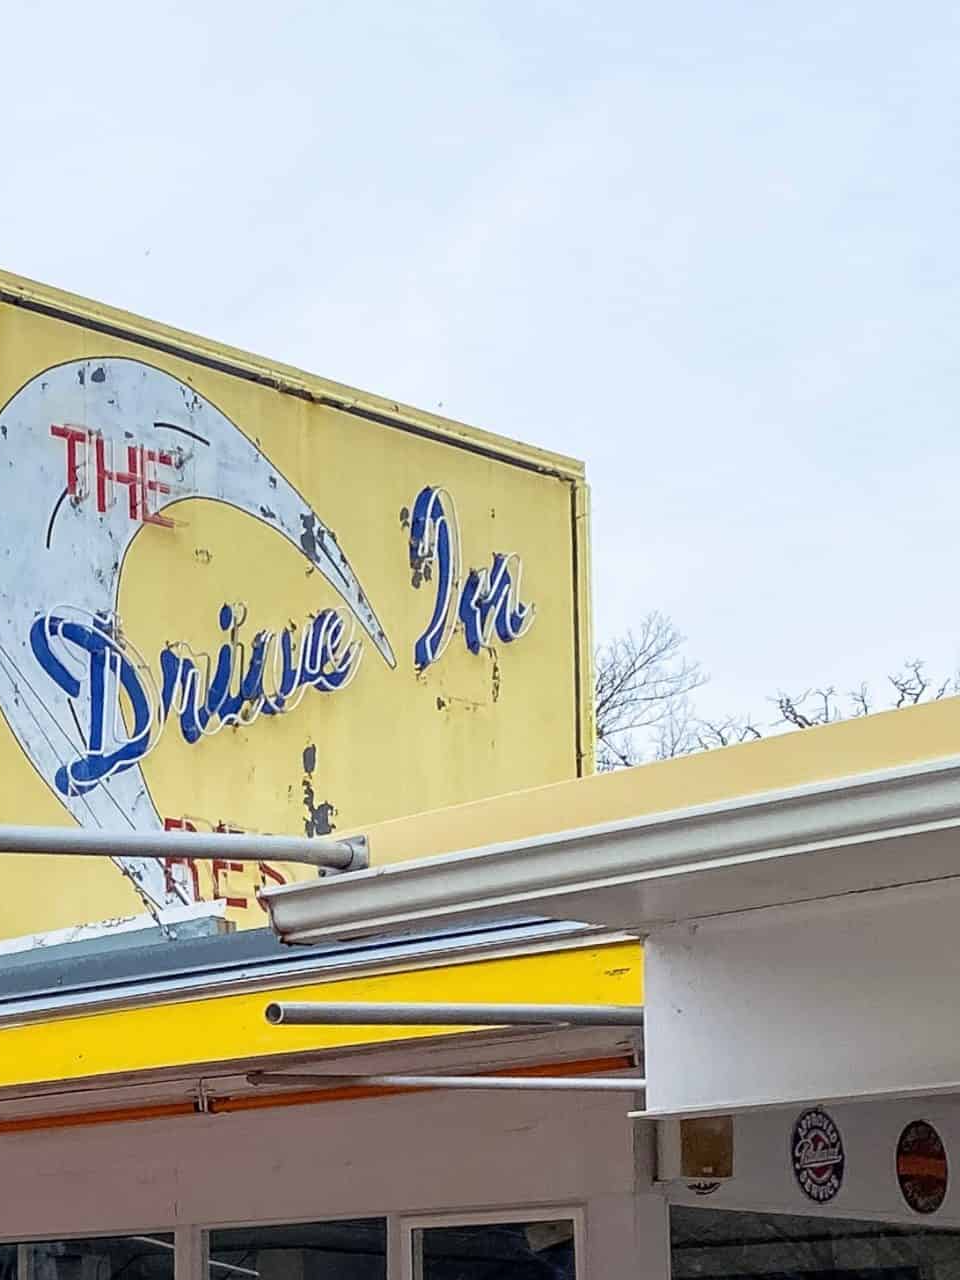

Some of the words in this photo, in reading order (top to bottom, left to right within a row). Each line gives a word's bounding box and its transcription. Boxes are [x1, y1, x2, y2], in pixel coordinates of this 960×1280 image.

[50, 423, 176, 529] THE
[29, 601, 362, 797] Drive
[406, 485, 536, 672] In
[800, 1169, 839, 1199] SERVICE
